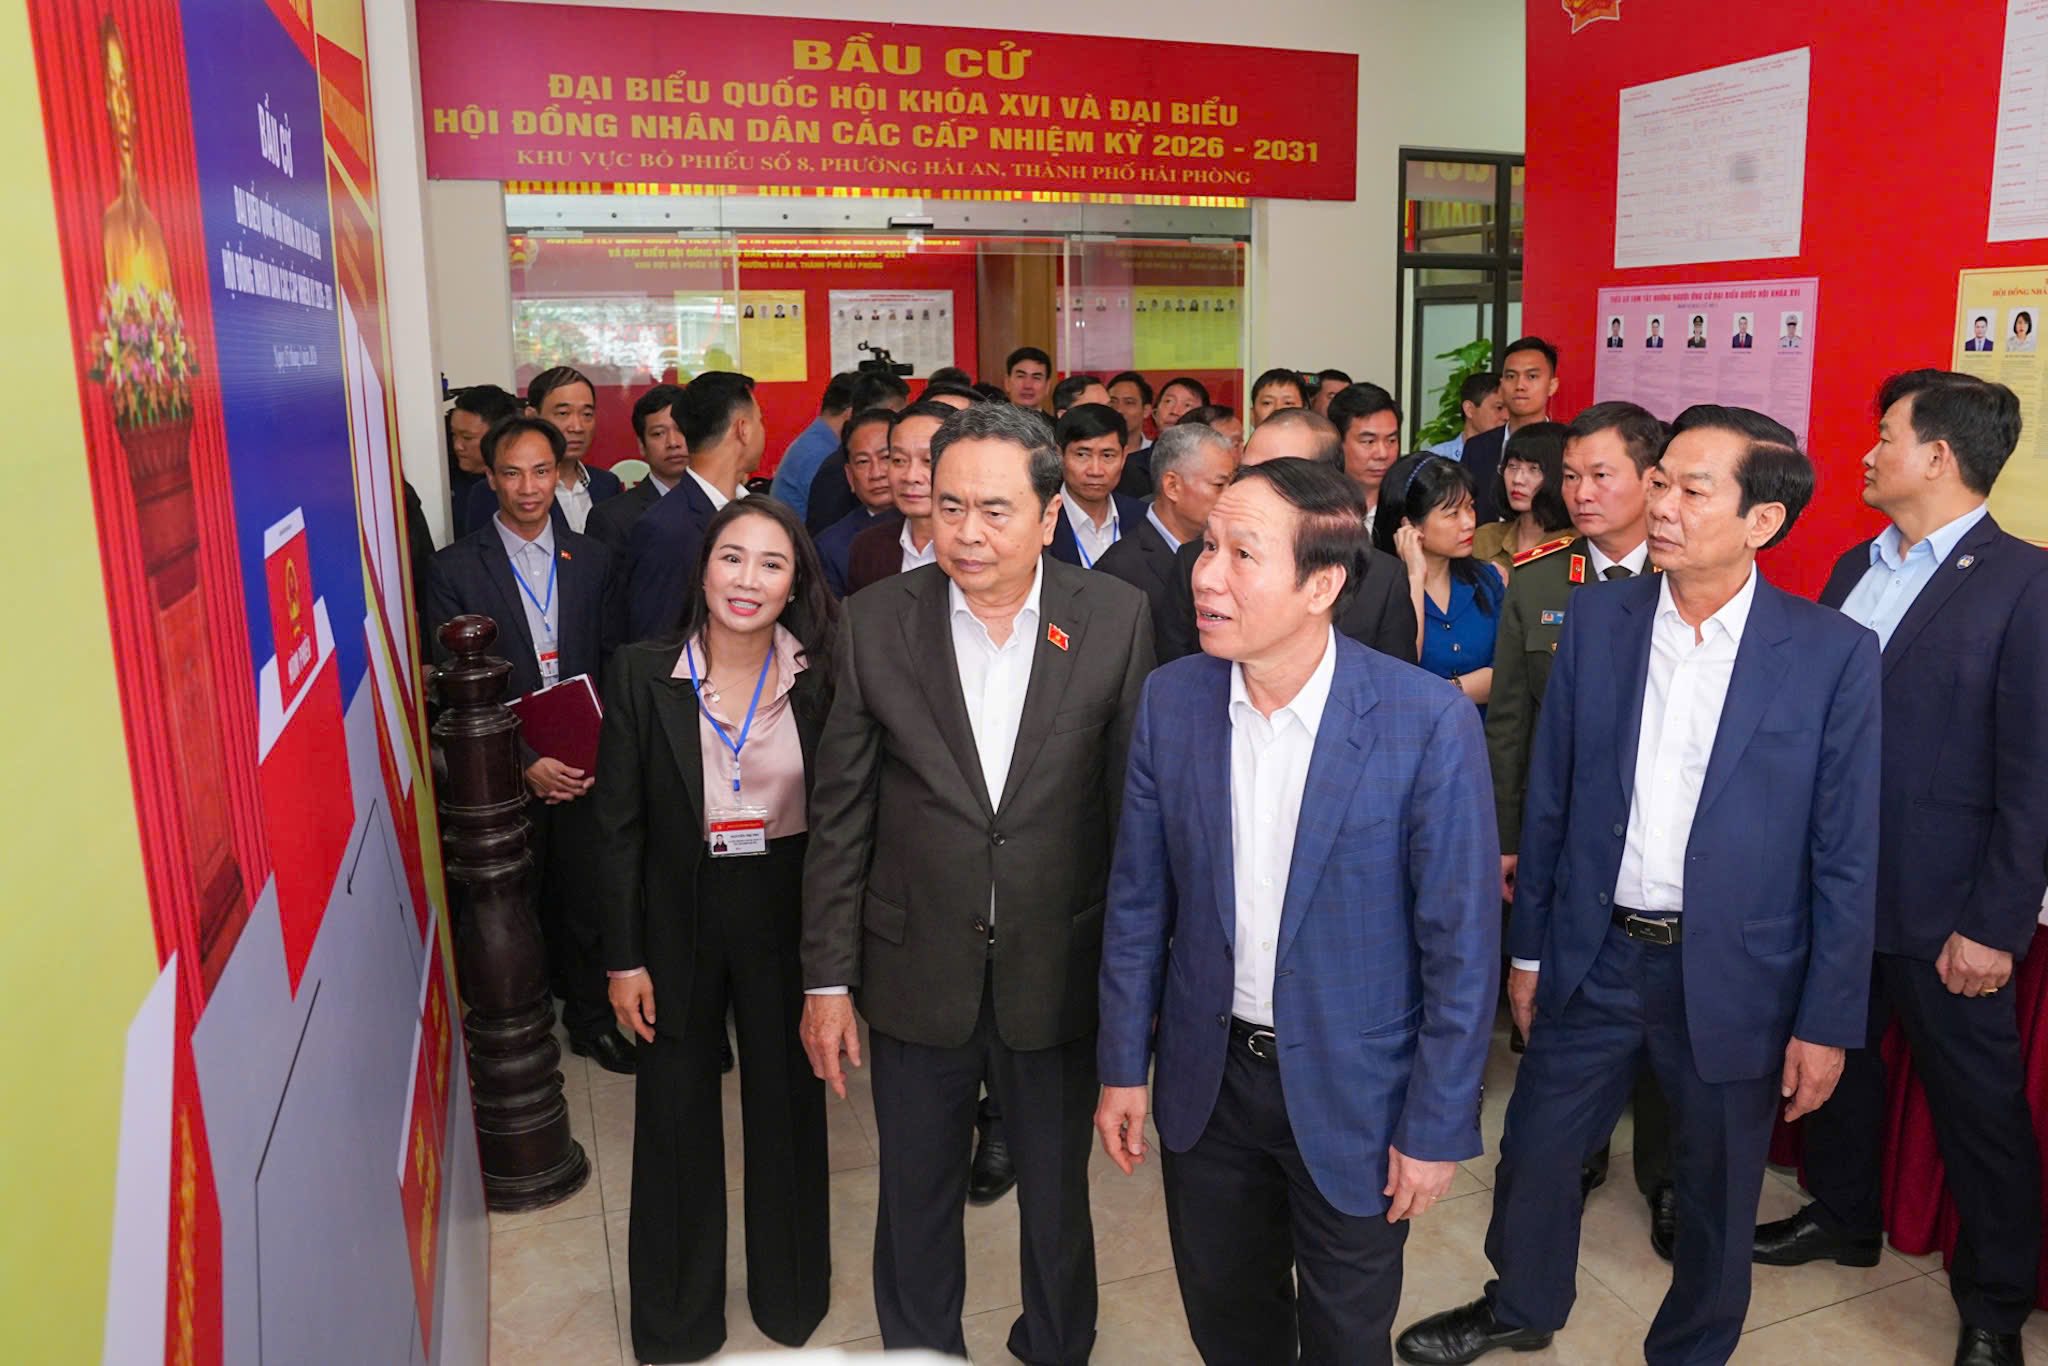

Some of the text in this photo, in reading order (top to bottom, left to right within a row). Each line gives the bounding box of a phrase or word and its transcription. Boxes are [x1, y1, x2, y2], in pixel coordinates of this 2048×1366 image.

[792, 32, 1032, 81] BẦU CỬ
[548, 69, 1238, 127] ĐẠI BIỂU QUỐC HỘI KHÓA XVI VÀ ĐẠI BIỂU
[257, 92, 281, 169] BẦU
[433, 104, 499, 138] HỘI
[512, 103, 618, 138] ĐỒNG
[631, 111, 735, 142] NHÂN
[747, 114, 821, 144] DÂN
[832, 117, 900, 147] CÁC
[912, 119, 978, 150] CẤP
[990, 126, 1095, 158] NHIỆM
[1104, 128, 1143, 156] KỲ
[1152, 134, 1225, 158] 2026
[1253, 139, 1319, 163] 2031
[517, 149, 573, 166] KHU
[582, 149, 633, 169] VỰC
[640, 149, 674, 168] BỎ
[681, 149, 754, 171] PHIẾU
[760, 150, 791, 171] SỐ
[821, 155, 918, 175] PHƯỜNG
[924, 157, 965, 177] HẢI
[1011, 161, 1087, 180] THÀNH
[1093, 162, 1135, 181] PHỐ
[1141, 165, 1178, 183] HẢI
[1183, 165, 1251, 185] PHÒNG
